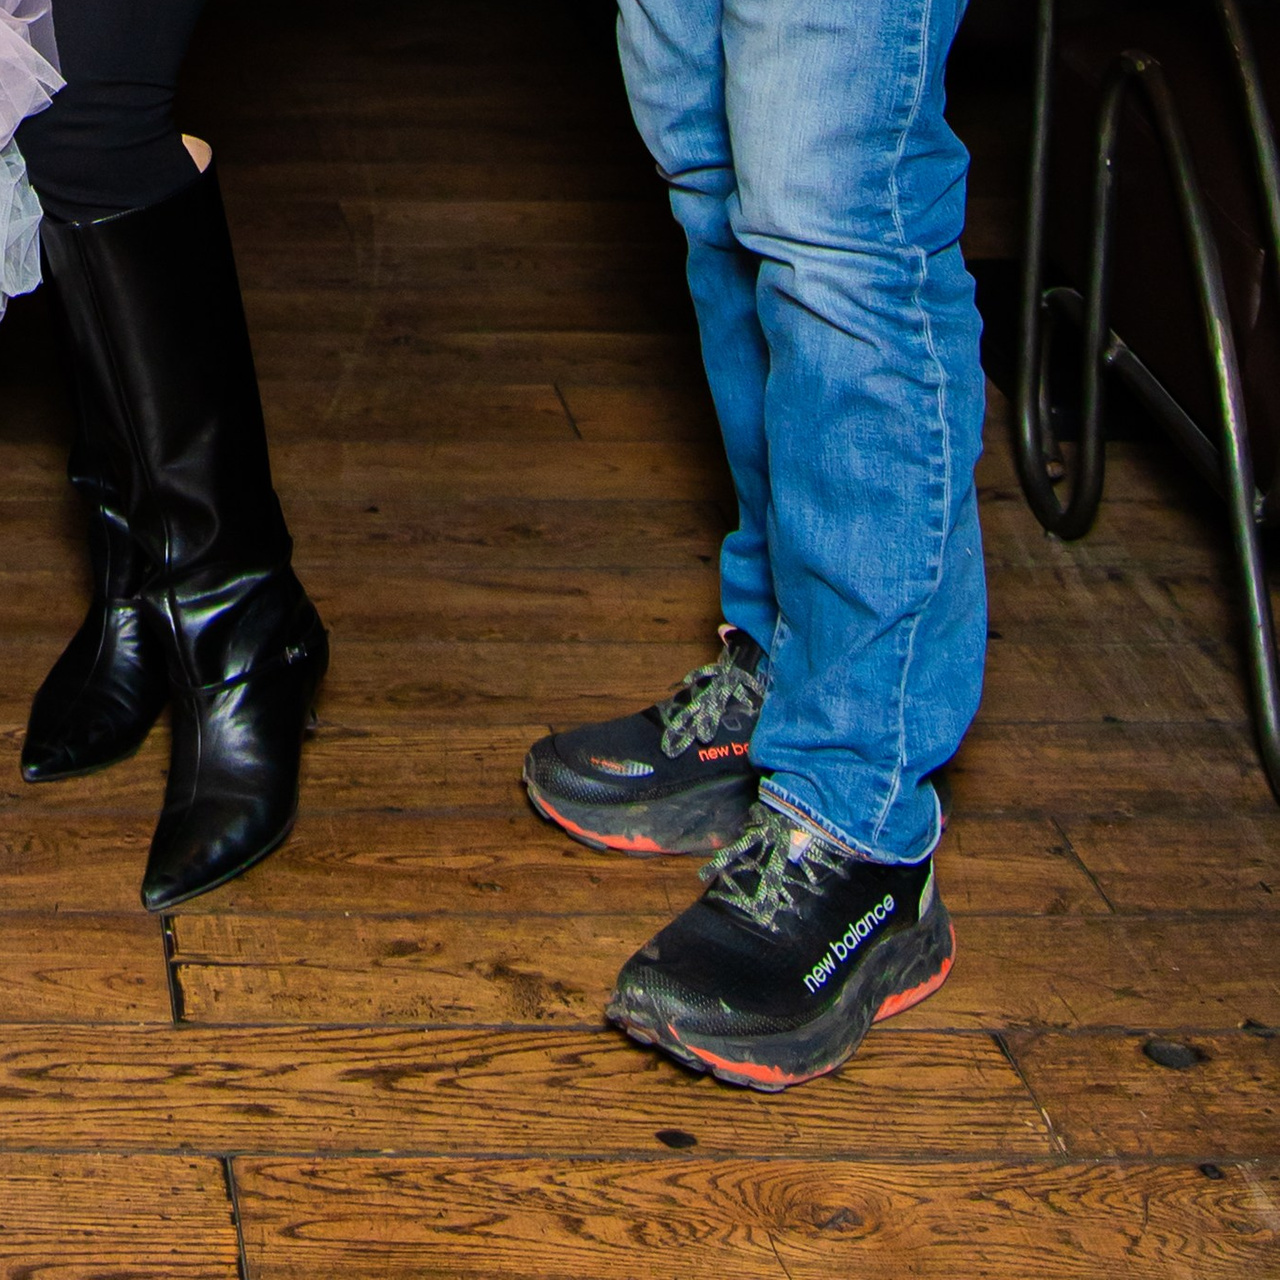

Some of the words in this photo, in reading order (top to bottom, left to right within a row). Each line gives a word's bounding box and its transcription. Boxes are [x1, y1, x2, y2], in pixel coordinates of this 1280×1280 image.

[698, 745, 729, 762] new
[803, 952, 836, 993] new
[829, 894, 895, 961] balance
